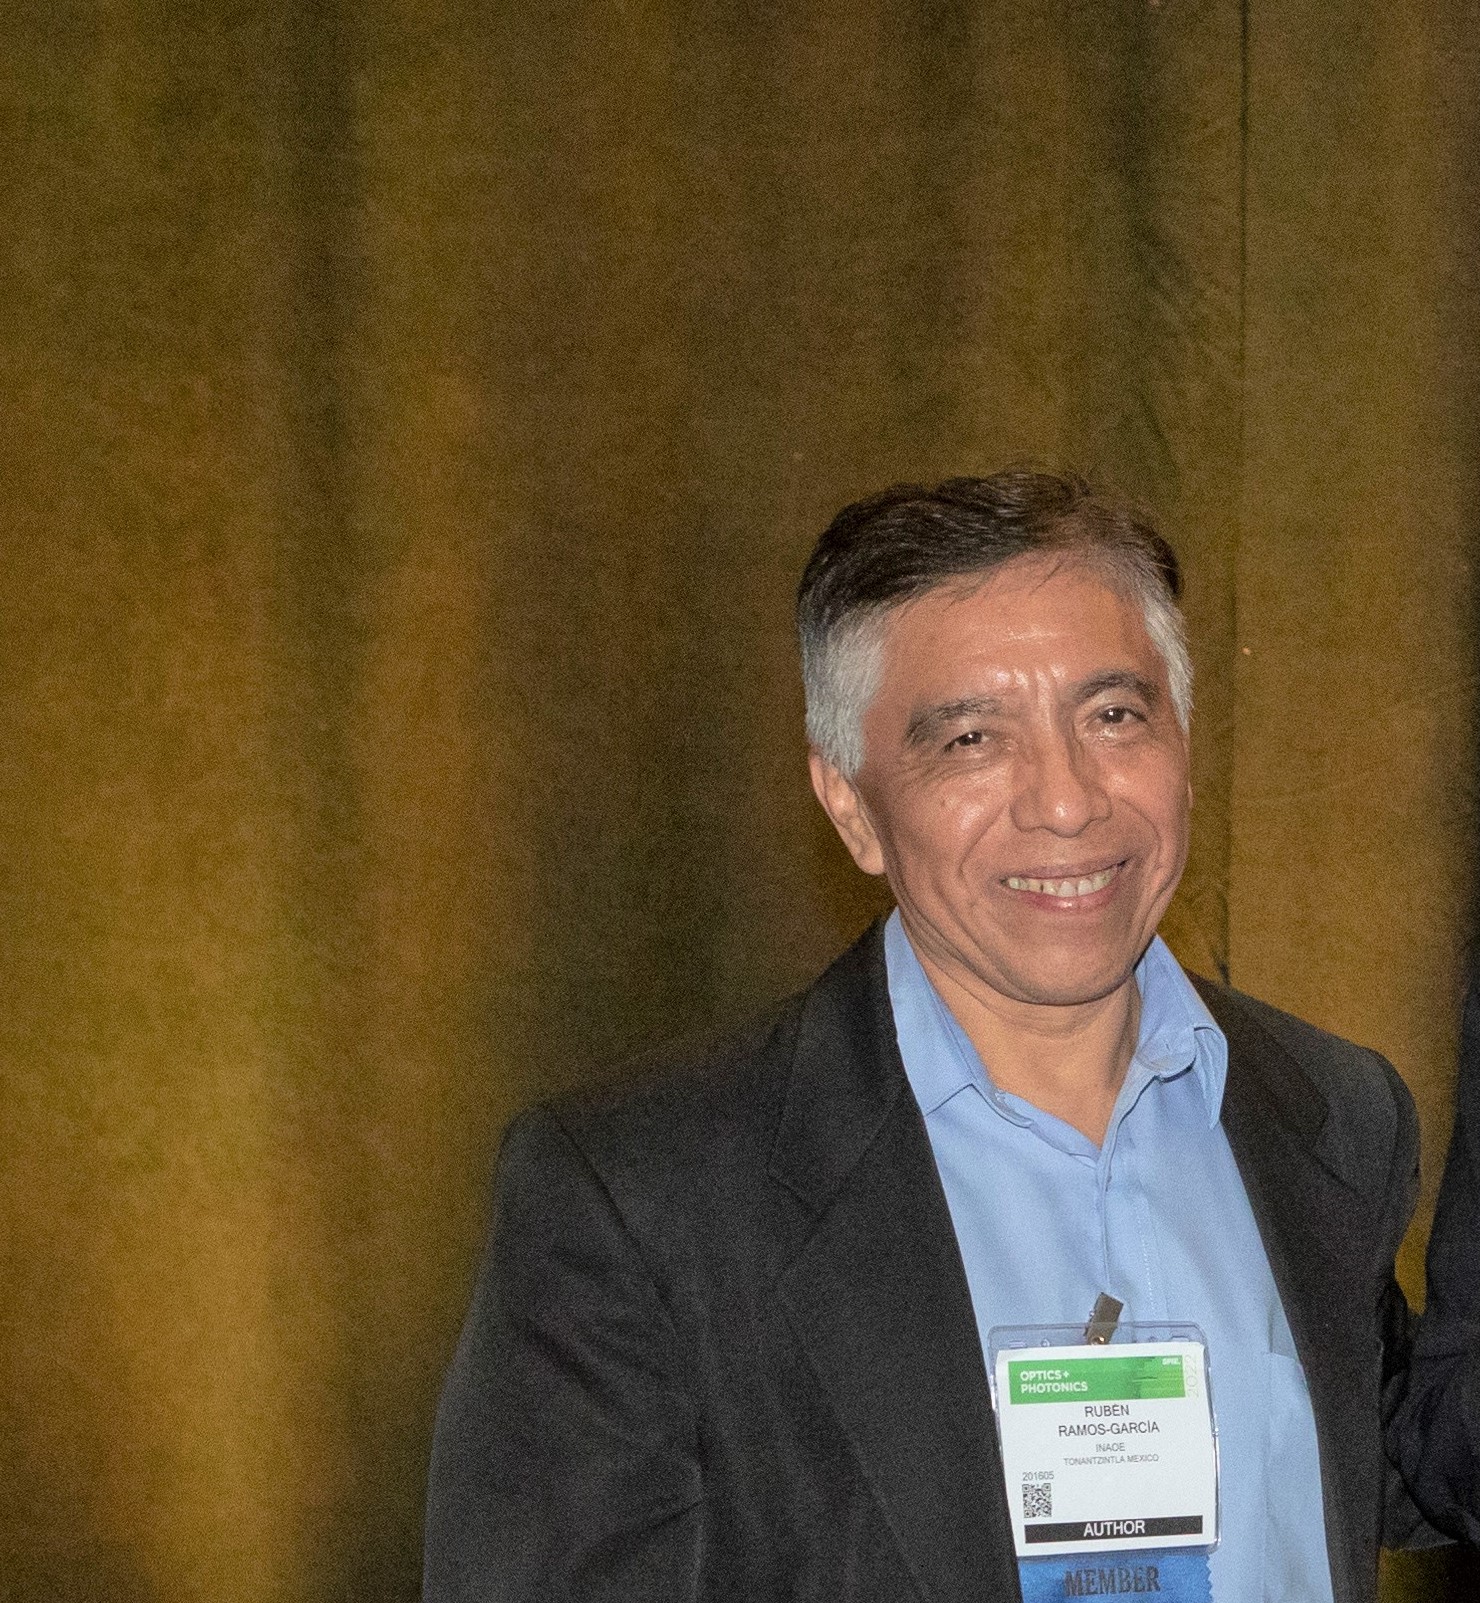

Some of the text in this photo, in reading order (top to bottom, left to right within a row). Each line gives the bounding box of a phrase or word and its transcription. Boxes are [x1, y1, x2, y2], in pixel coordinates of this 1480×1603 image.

[1019, 1369, 1070, 1382] OPTICS+
[1020, 1381, 1089, 1394] PHOTONICS
[1084, 1404, 1130, 1418] RUBÉN
[1058, 1419, 1160, 1437] RAMOS-GARCÍA
[1095, 1442, 1125, 1453] INAOE
[1126, 1453, 1159, 1463] MEXICO
[1083, 1519, 1146, 1537] AUTHOR
[1062, 1565, 1161, 1598] MEMBER
